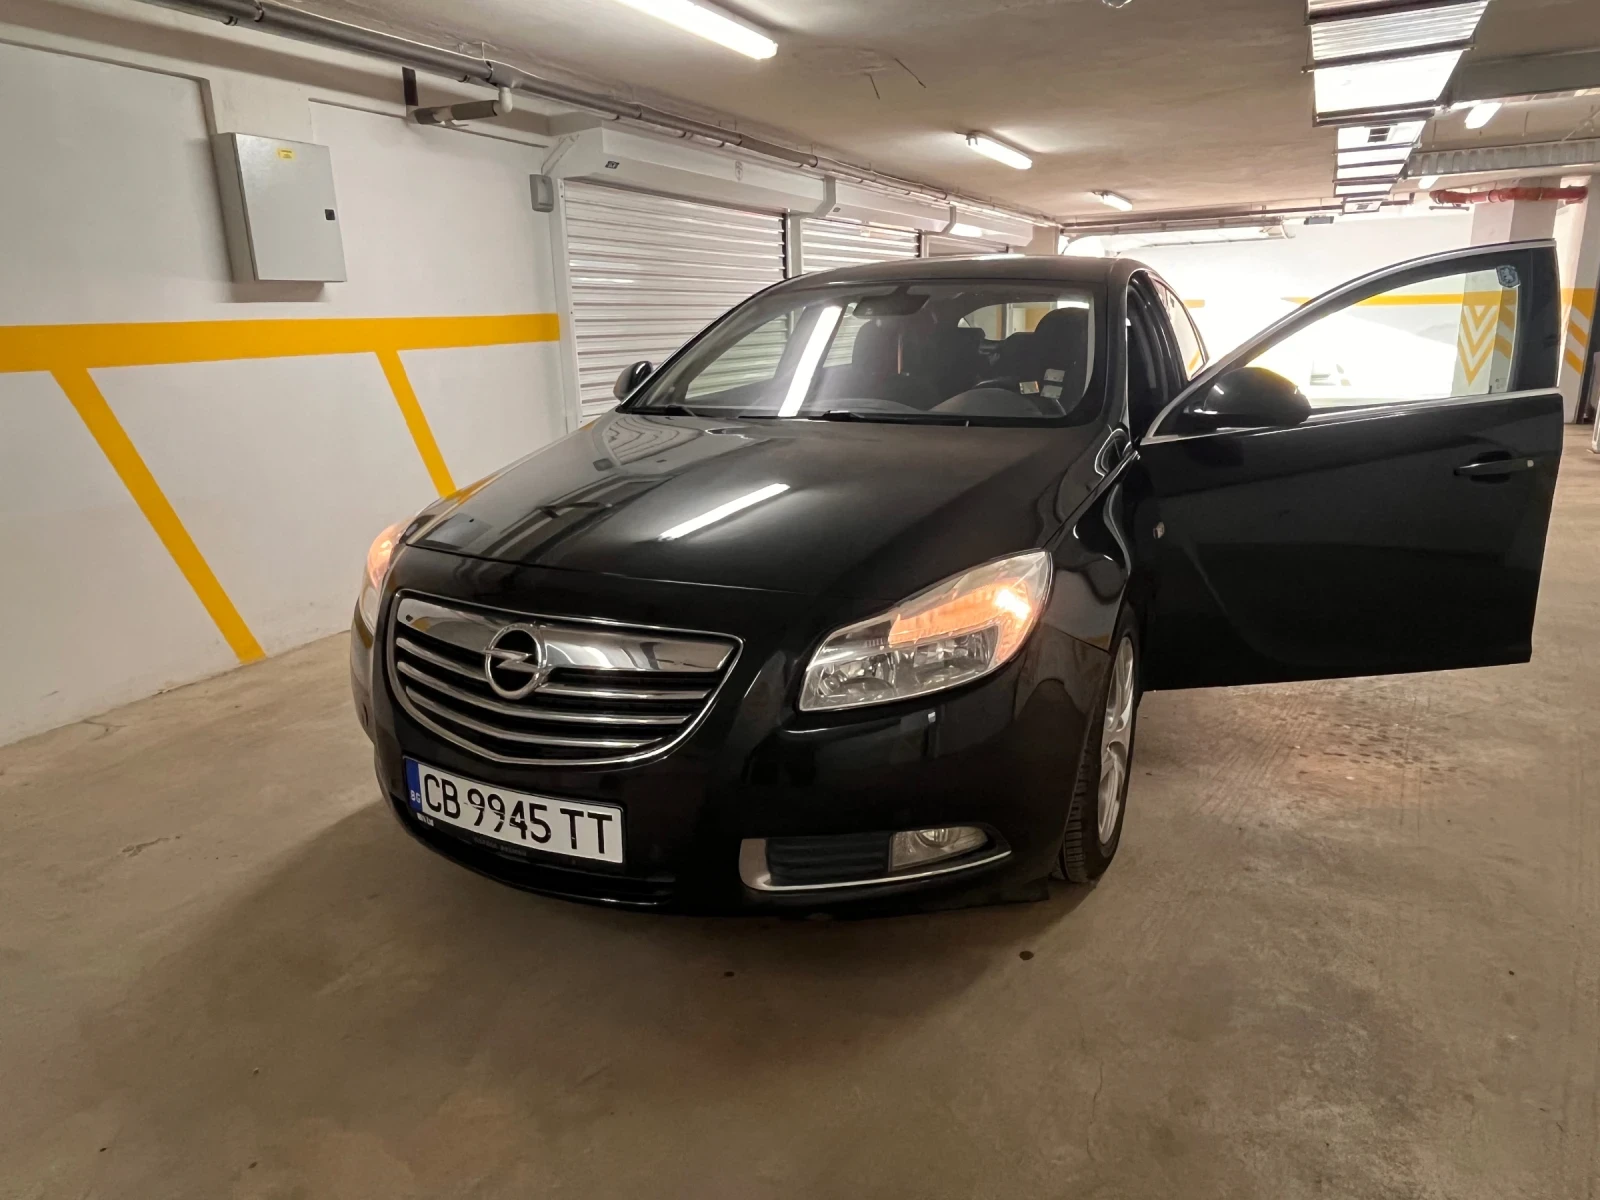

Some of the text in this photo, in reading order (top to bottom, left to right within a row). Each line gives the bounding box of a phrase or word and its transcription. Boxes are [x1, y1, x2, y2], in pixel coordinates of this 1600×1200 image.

[410, 789, 421, 804] BG
[424, 773, 461, 819] CB
[467, 788, 552, 843] 9945
[560, 808, 613, 854] TT
